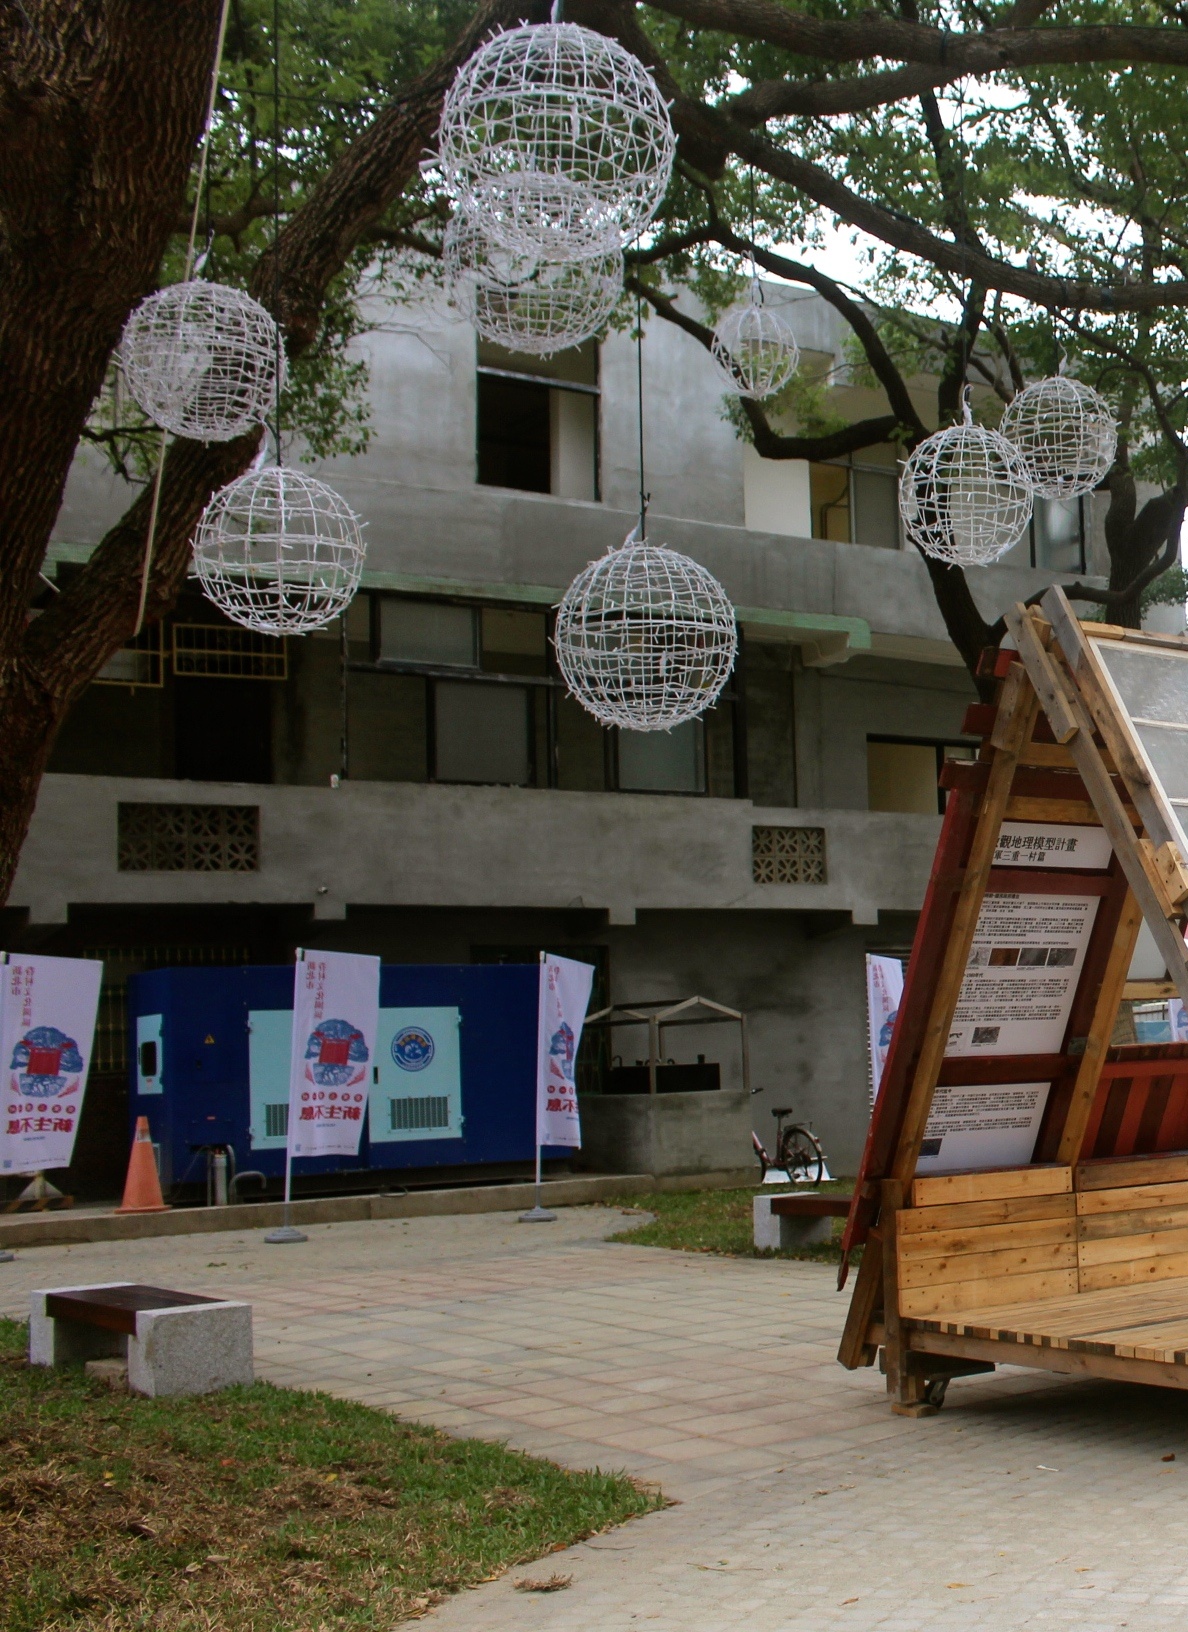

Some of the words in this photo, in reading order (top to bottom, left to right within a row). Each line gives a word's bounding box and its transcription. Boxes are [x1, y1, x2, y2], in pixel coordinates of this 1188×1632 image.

[995, 834, 1078, 852] 觀地理模型計畫
